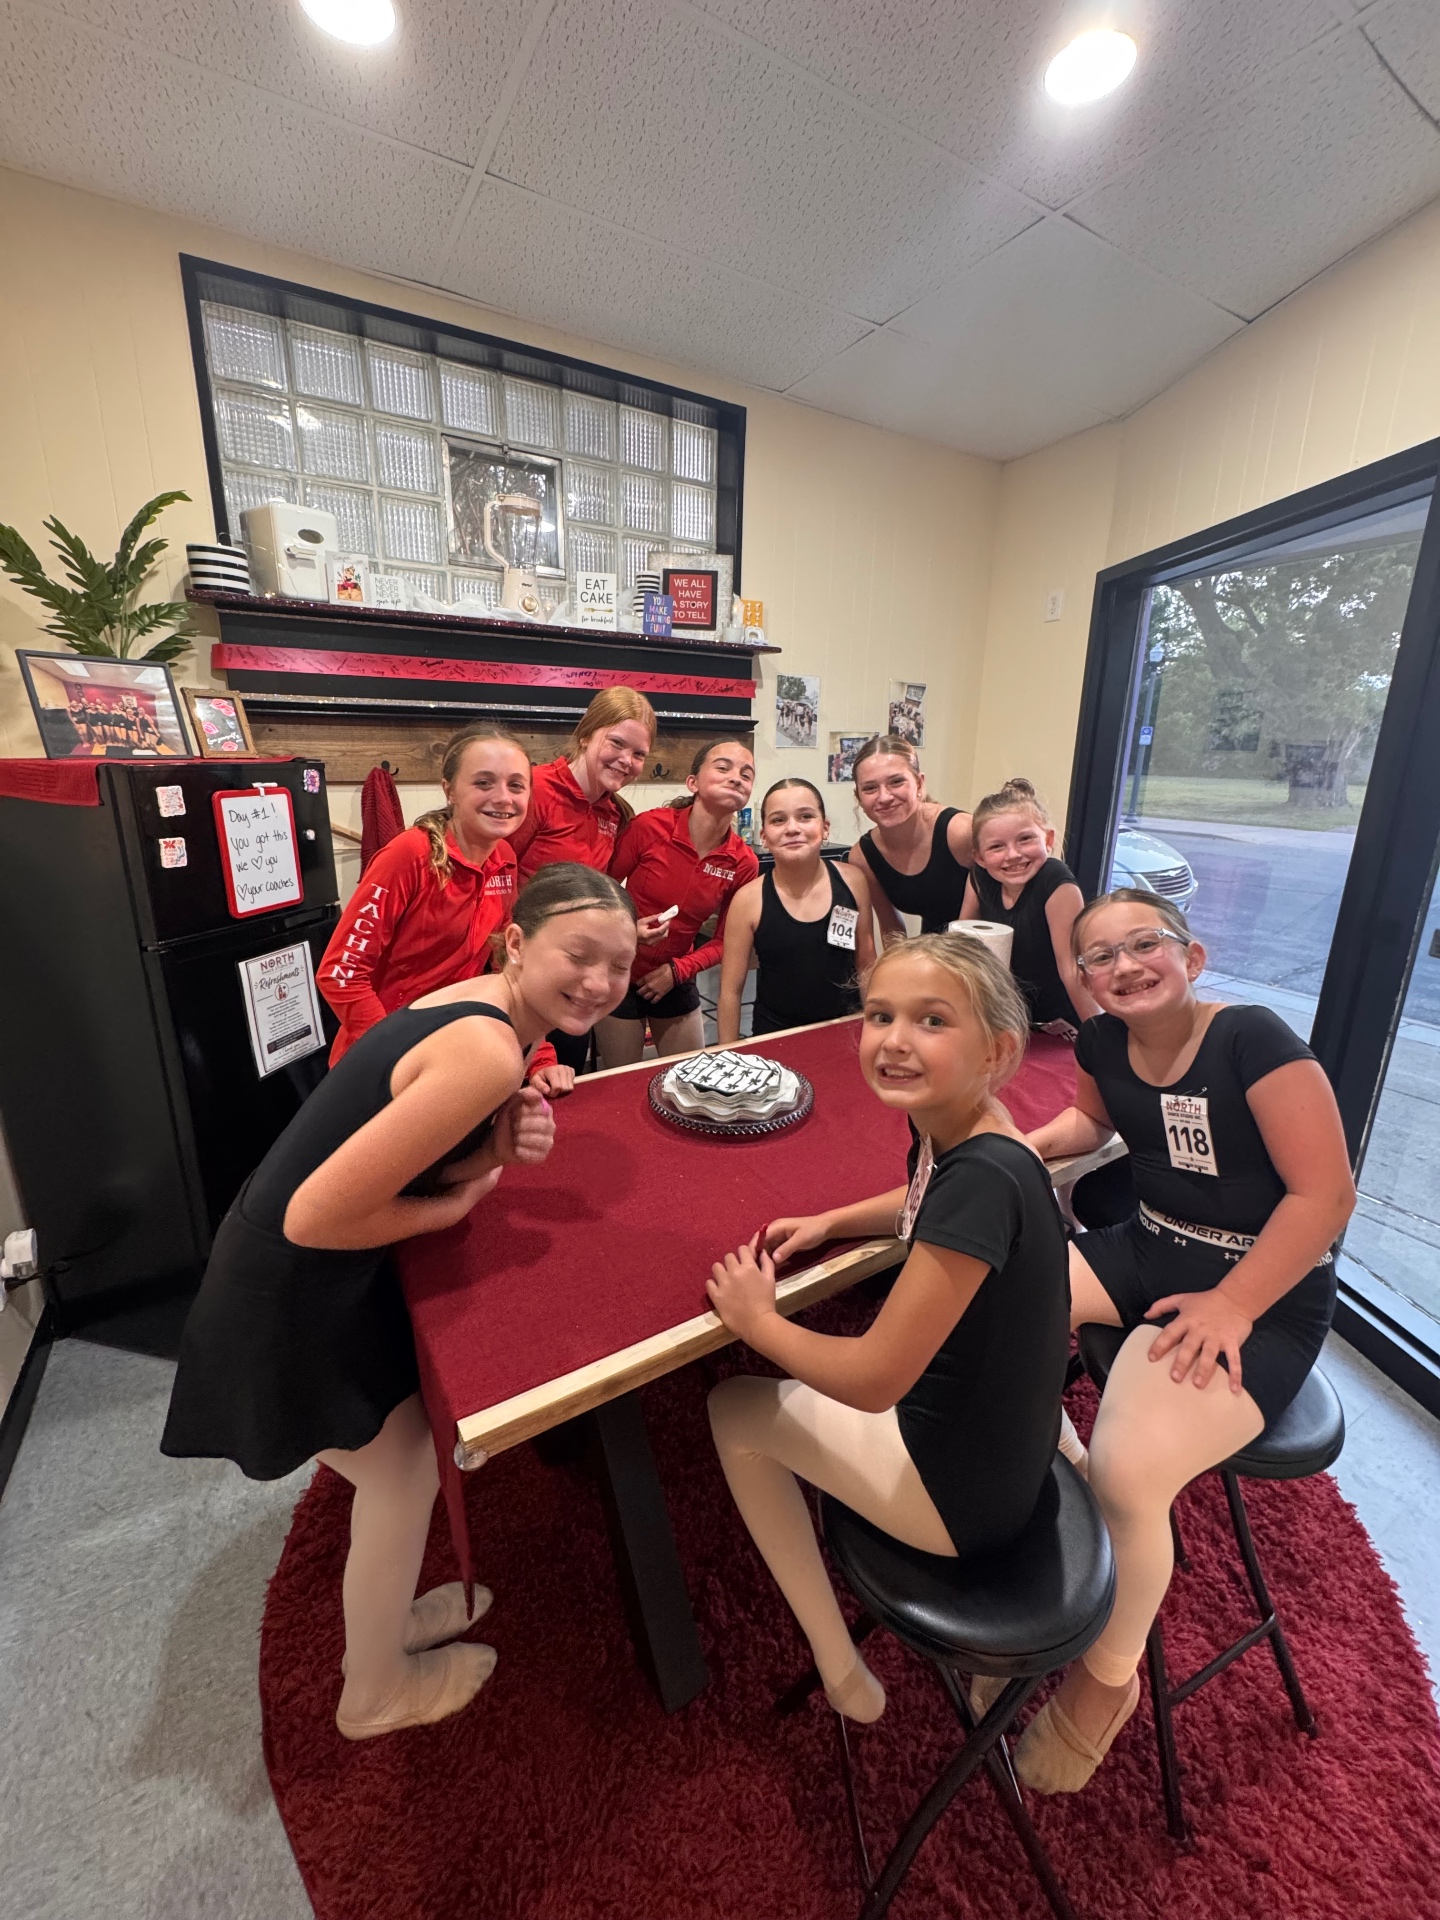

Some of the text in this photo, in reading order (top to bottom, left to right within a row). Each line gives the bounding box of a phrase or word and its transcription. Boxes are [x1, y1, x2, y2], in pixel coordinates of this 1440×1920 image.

[374, 577, 398, 585] NEVER
[585, 578, 608, 591] EAT
[673, 578, 707, 588] WE ALL
[375, 584, 399, 592] NEVER
[376, 591, 400, 599] NEVER
[580, 591, 613, 605] CAKE
[678, 590, 702, 599] HAVE
[652, 596, 665, 606] YOU
[672, 600, 709, 610] A STORY
[649, 606, 668, 615] MAKE
[674, 610, 707, 620] TO TELL
[581, 614, 614, 625] for breakfast
[645, 613, 671, 625] LEARNING
[650, 623, 665, 634] FUN!
[228, 809, 252, 828] Day
[255, 833, 270, 853] got
[272, 830, 289, 842] this
[265, 855, 278, 874] you
[247, 877, 295, 904] your coaches
[831, 922, 853, 940] 104
[260, 952, 295, 971] NORTH
[259, 967, 301, 991] Refreshments
[1166, 1100, 1201, 1115] NORTH
[1168, 1124, 1210, 1156] 118
[1163, 1214, 1223, 1242] UNDER
